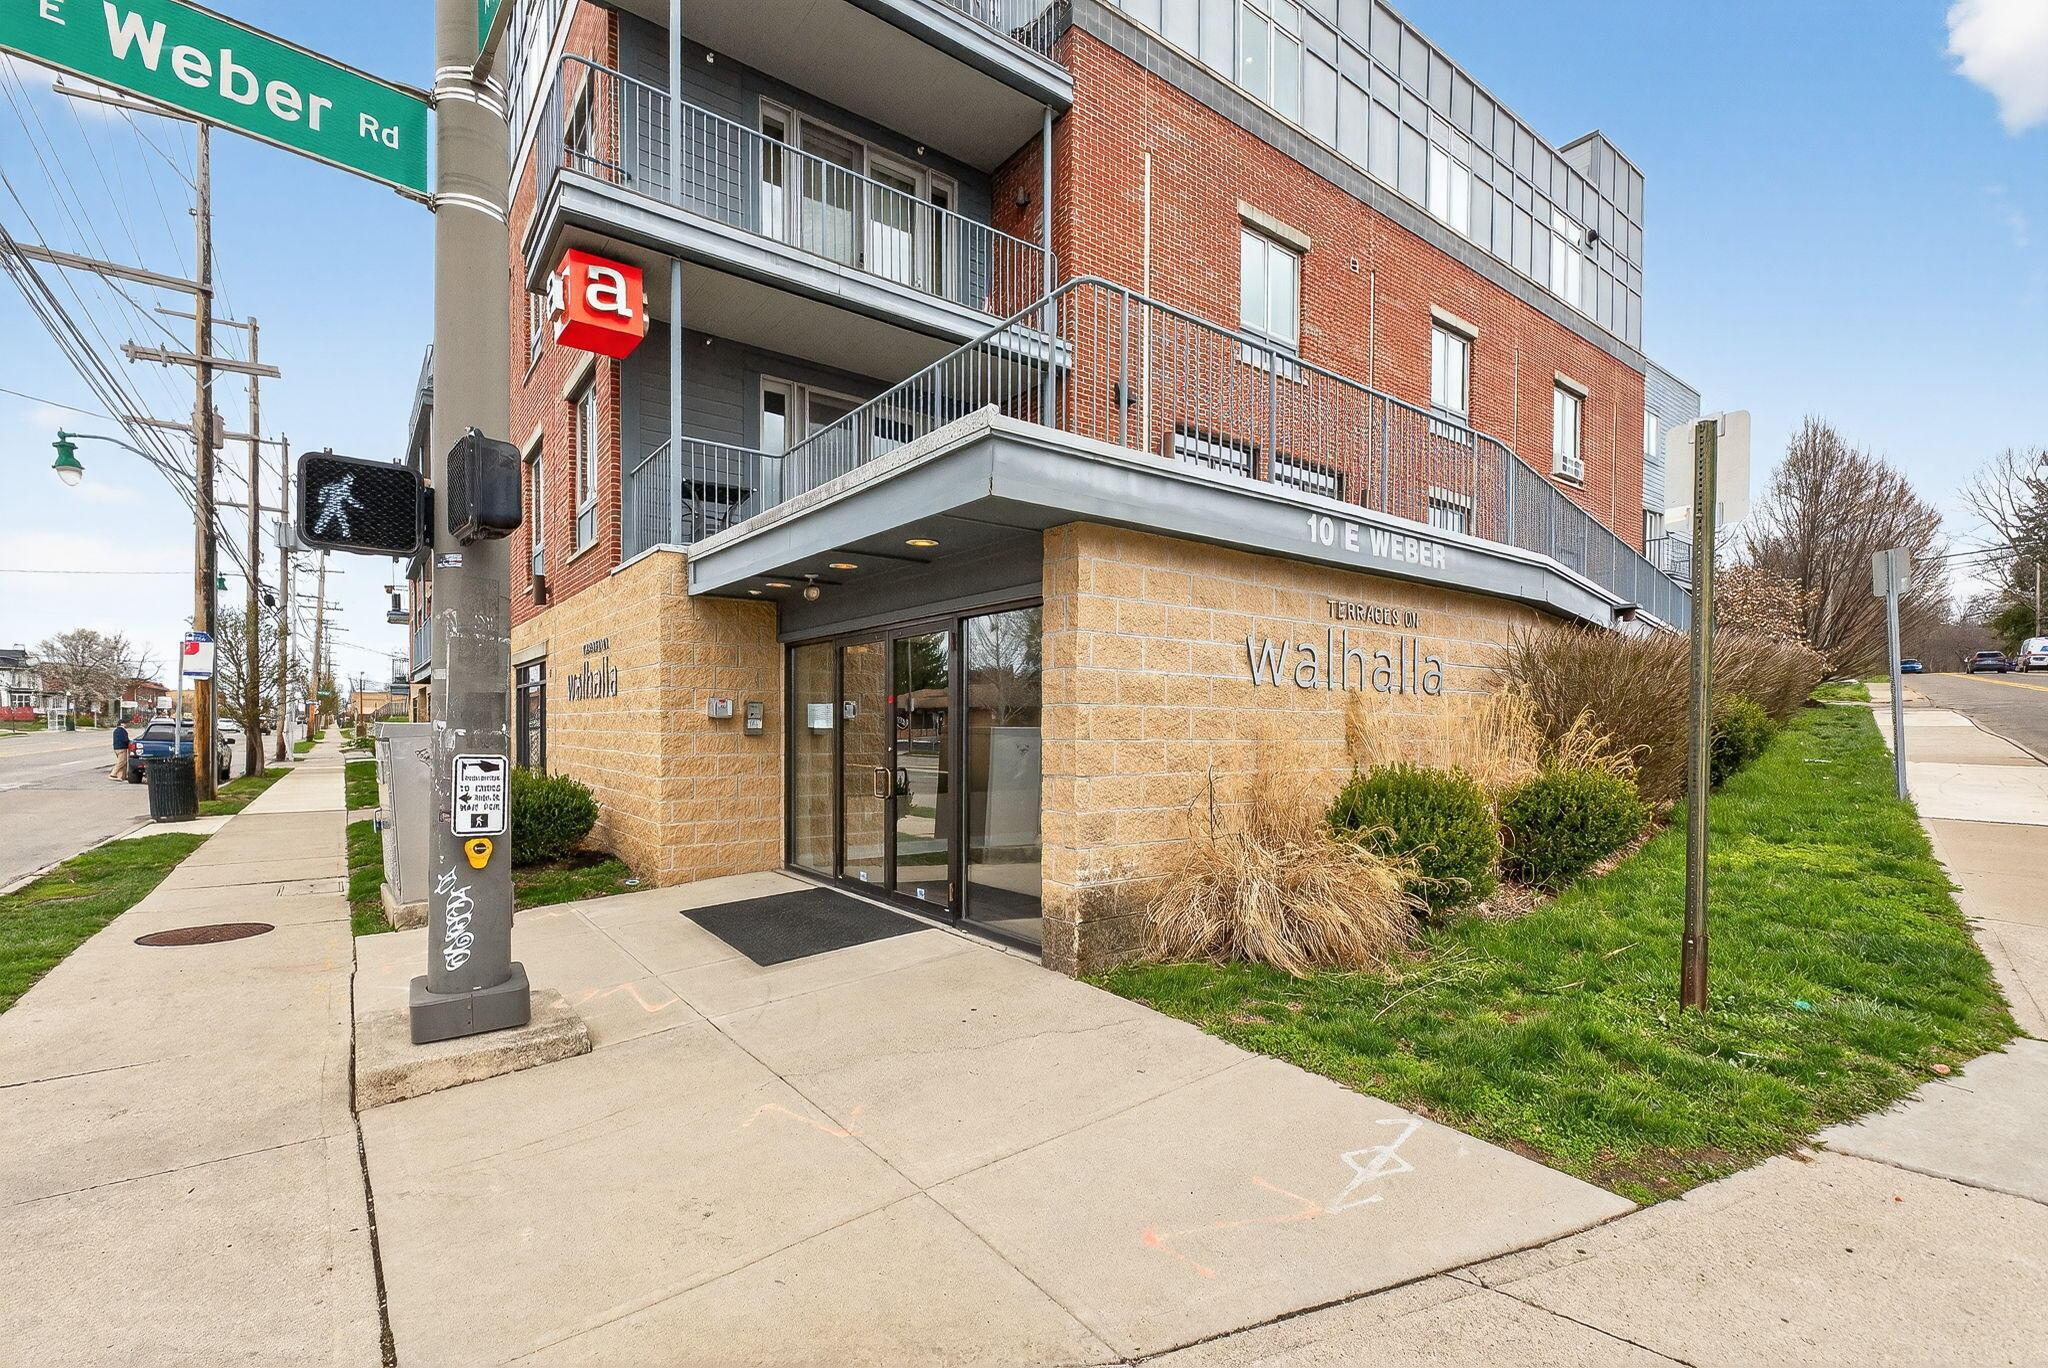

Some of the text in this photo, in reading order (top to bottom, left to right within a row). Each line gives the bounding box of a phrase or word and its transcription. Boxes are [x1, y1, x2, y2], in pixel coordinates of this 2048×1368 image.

[39, 0, 400, 150] E Weber Rd
[586, 265, 633, 318] a
[1307, 513, 1446, 570] 10 E WEBER
[1327, 600, 1418, 629] TERRACES ON
